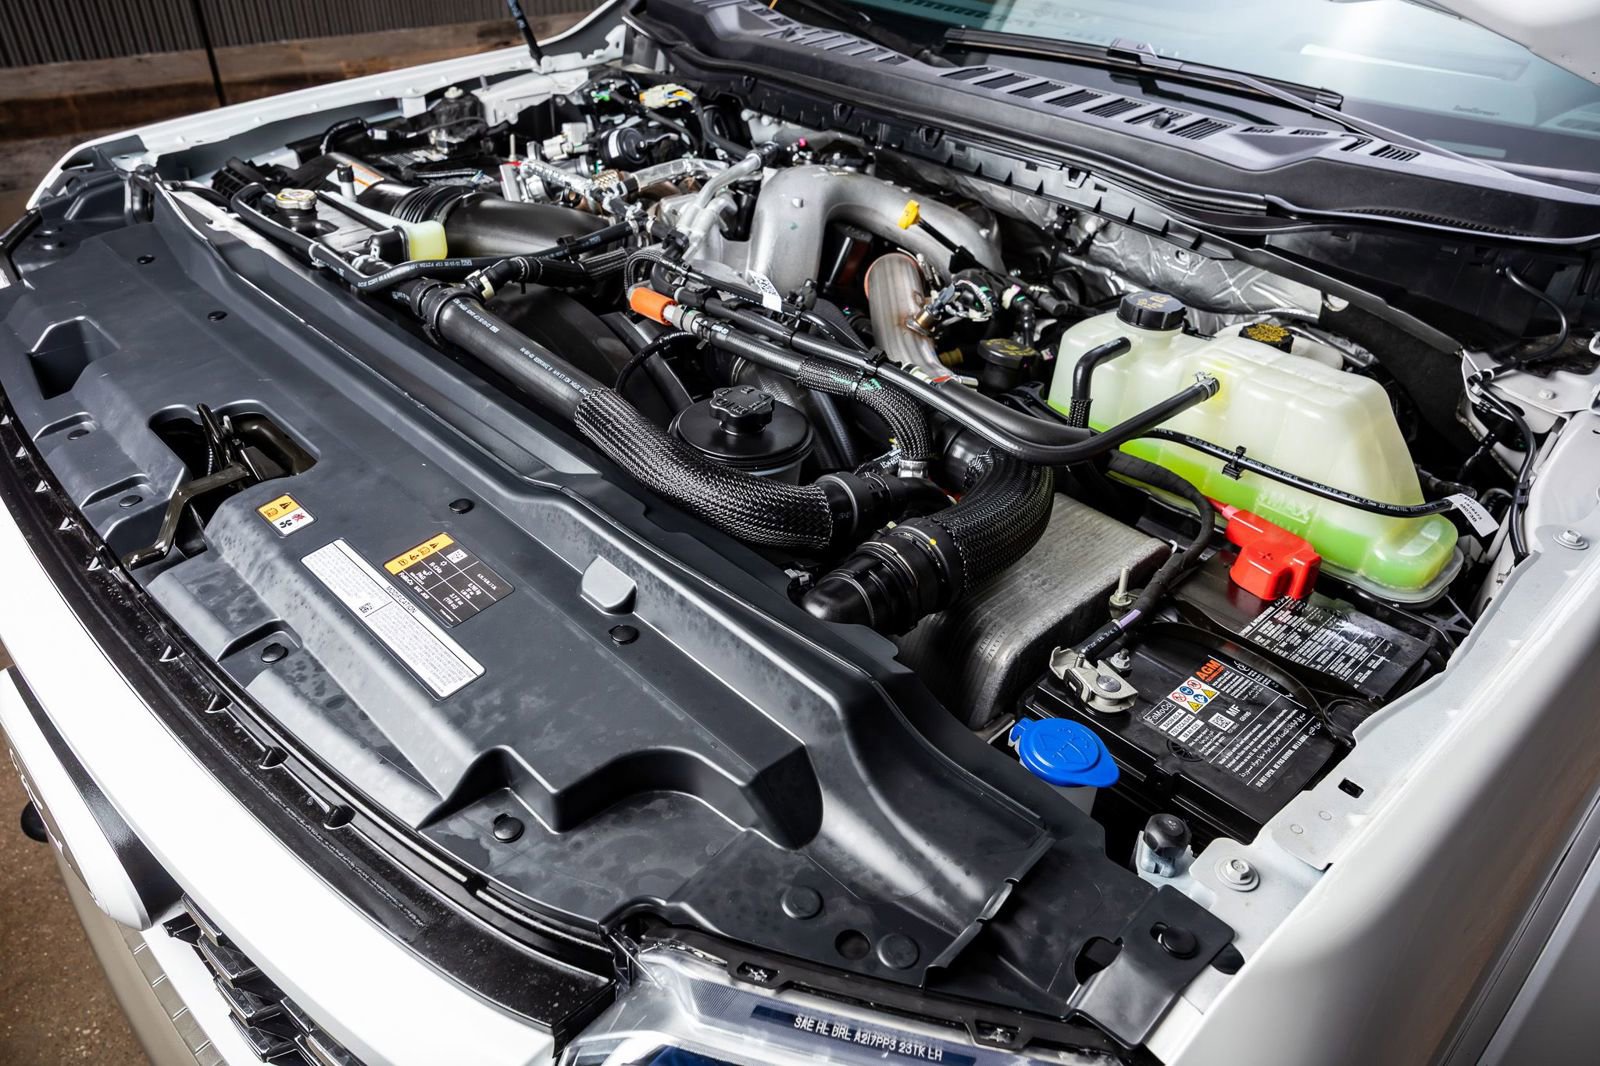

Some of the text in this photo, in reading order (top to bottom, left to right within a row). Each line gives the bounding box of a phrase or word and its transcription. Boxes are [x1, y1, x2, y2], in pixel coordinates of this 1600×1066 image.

[386, 586, 417, 614] MODIFICATION
[1193, 659, 1221, 680] AGM
[1146, 700, 1173, 723] FoMoCo
[1224, 702, 1242, 716] MF
[793, 1015, 815, 1032] SAE
[815, 1020, 830, 1036] HL
[831, 1023, 851, 1041] DRL
[898, 1039, 926, 1058] 23TK
[927, 1045, 943, 1061] LH
